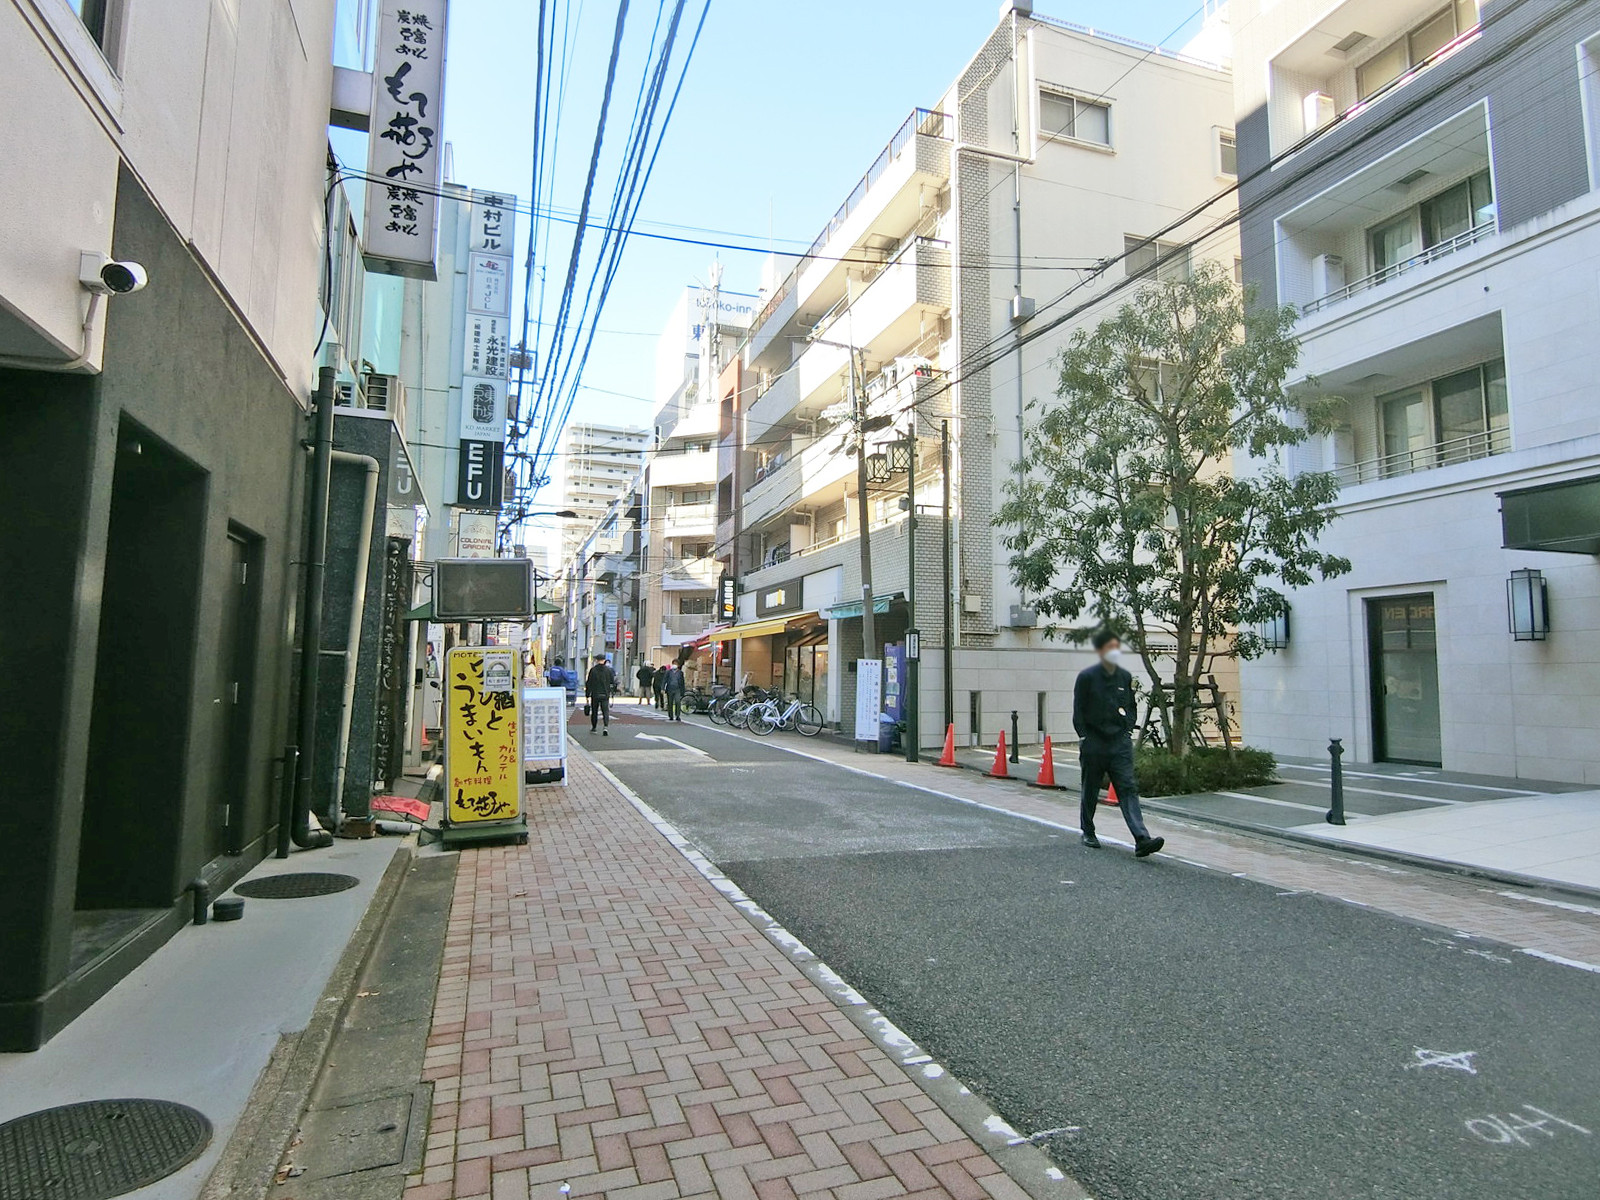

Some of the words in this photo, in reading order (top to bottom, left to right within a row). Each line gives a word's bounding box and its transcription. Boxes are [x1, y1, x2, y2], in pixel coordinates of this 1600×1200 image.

[397, 10, 432, 30] 炭焼
[395, 45, 428, 60] おでん
[387, 186, 424, 205] 炭焼
[385, 221, 419, 237] おでん
[482, 195, 503, 250] 中村ビル
[485, 335, 499, 376] 永光建設
[466, 442, 484, 500] EFU
[460, 537, 493, 545] COLONIAL
[462, 543, 491, 551] GARDEN
[499, 745, 508, 780] カクテル
[454, 776, 492, 787] 創作料理
